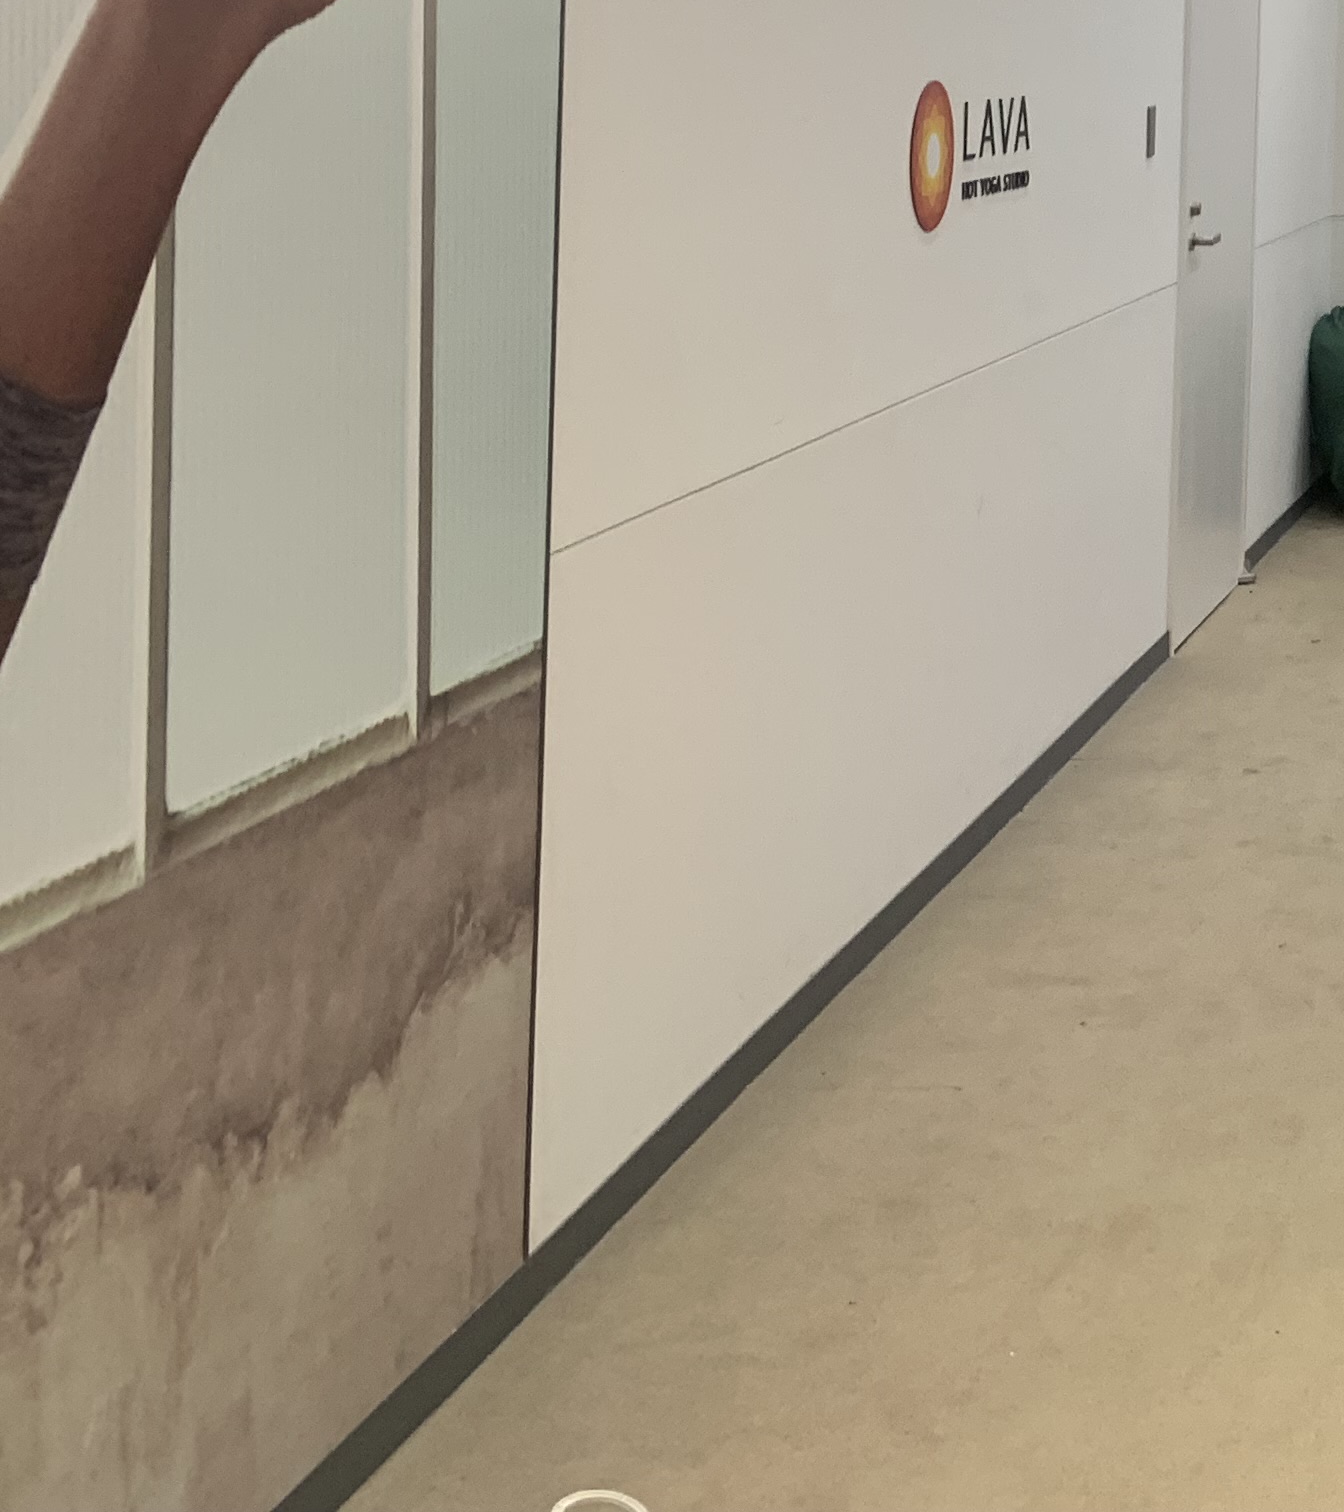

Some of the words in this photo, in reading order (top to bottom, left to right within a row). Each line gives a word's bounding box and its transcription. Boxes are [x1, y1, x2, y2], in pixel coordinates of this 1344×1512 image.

[963, 95, 1030, 161] LAVA
[962, 179, 978, 201] HOT
[979, 175, 1002, 197] YOGA
[1003, 170, 1030, 192] STUDIO
